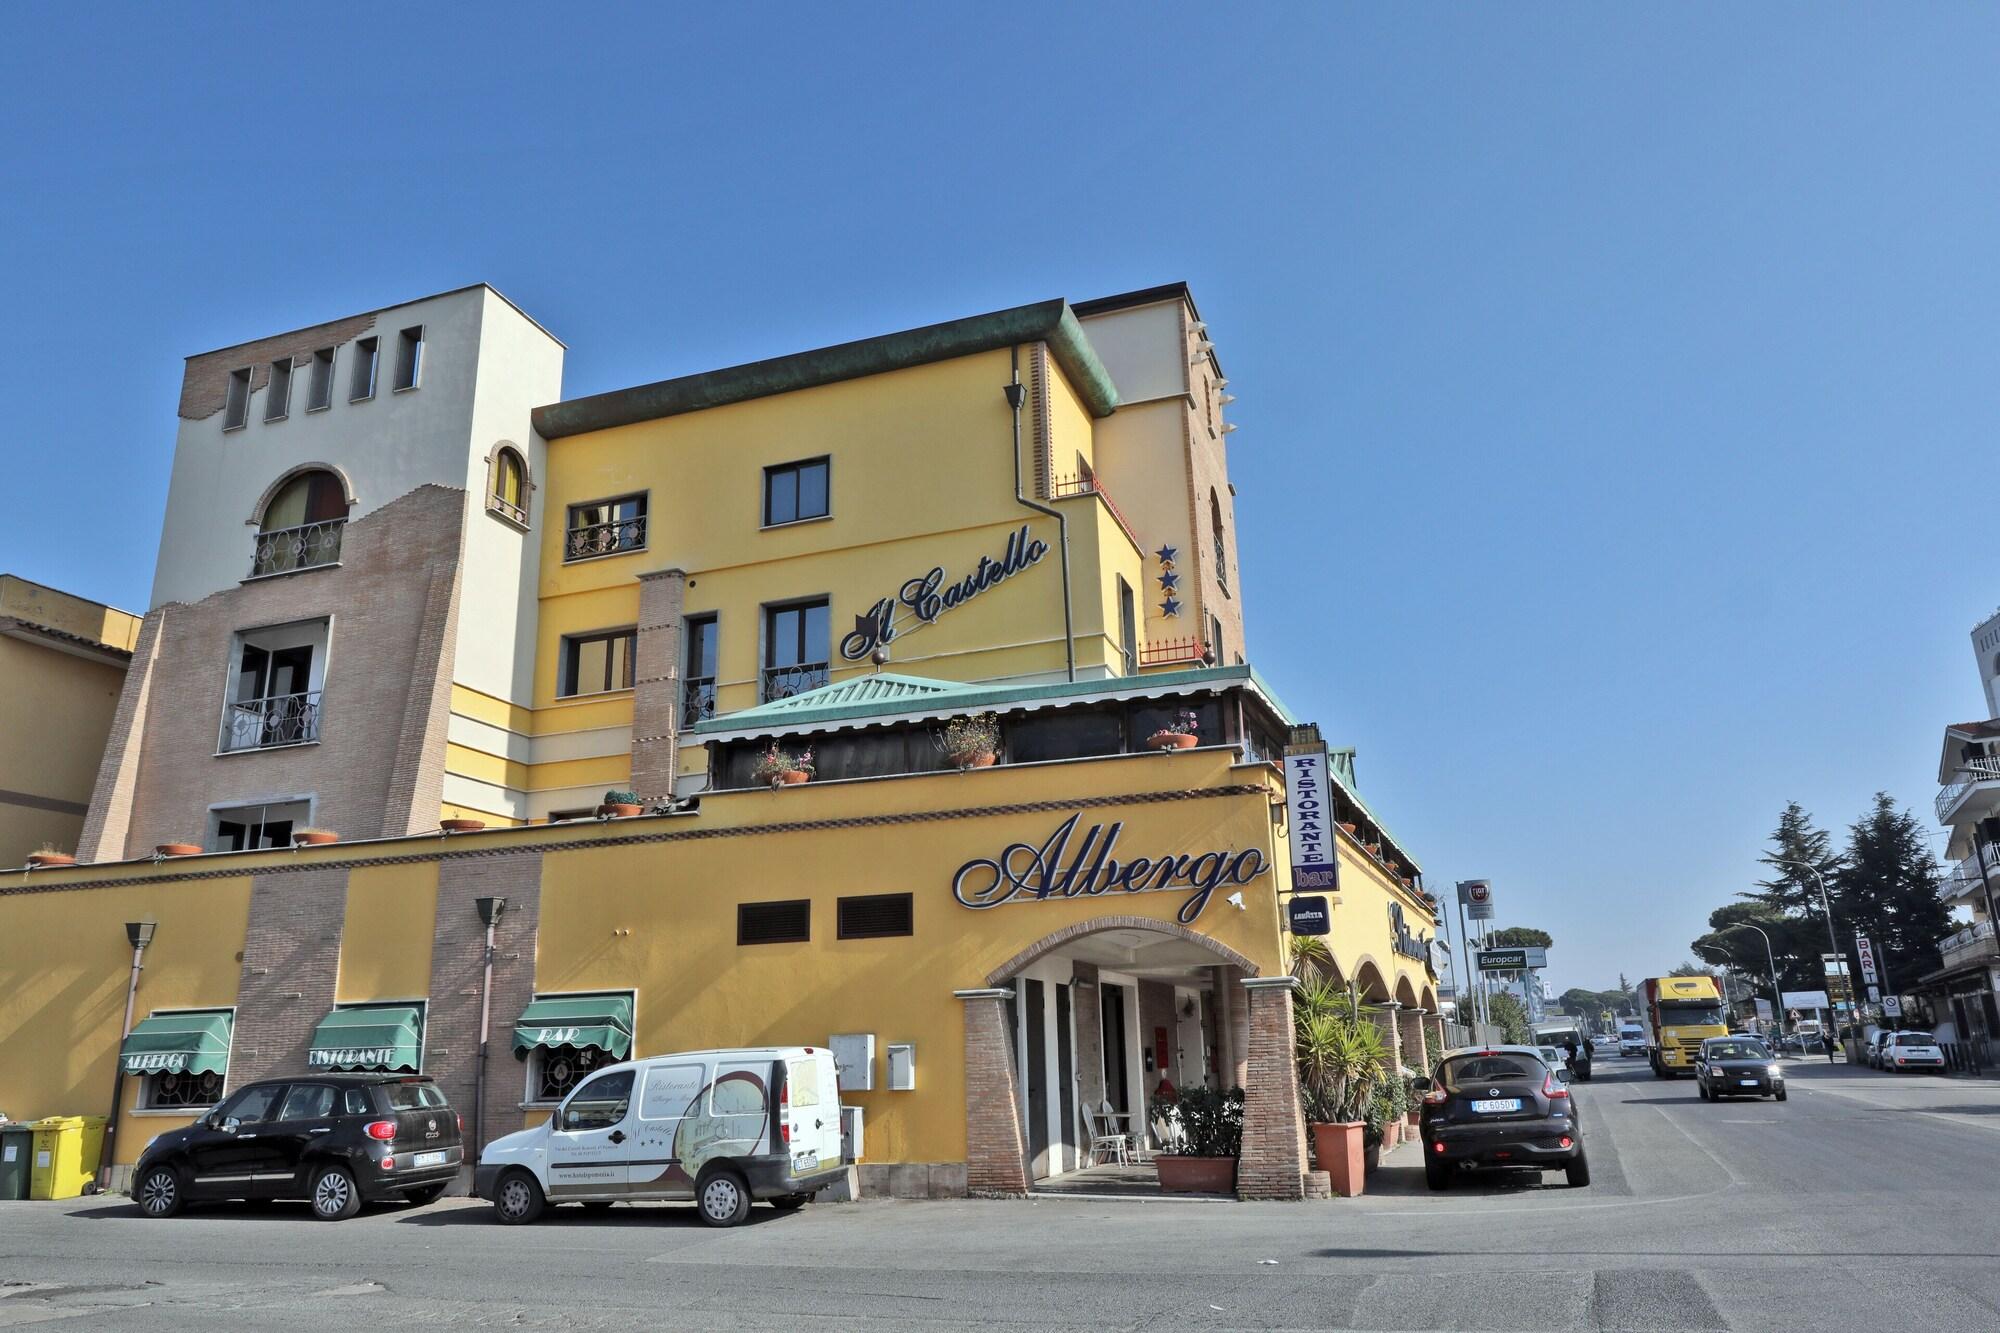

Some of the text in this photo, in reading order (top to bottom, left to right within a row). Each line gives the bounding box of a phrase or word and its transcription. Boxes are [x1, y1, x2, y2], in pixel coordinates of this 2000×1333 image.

[900, 525, 1050, 625] Castello
[1294, 758, 1324, 864] RISTORANTE
[952, 811, 1272, 925] Albergo
[1294, 867, 1334, 887] bar
[1294, 910, 1323, 920] LAVAZZA
[1481, 955, 1522, 966] Europcar
[536, 1028, 580, 1042] BAR
[125, 1053, 188, 1069] ALBERGO
[308, 1048, 396, 1065] RISTORANTE
